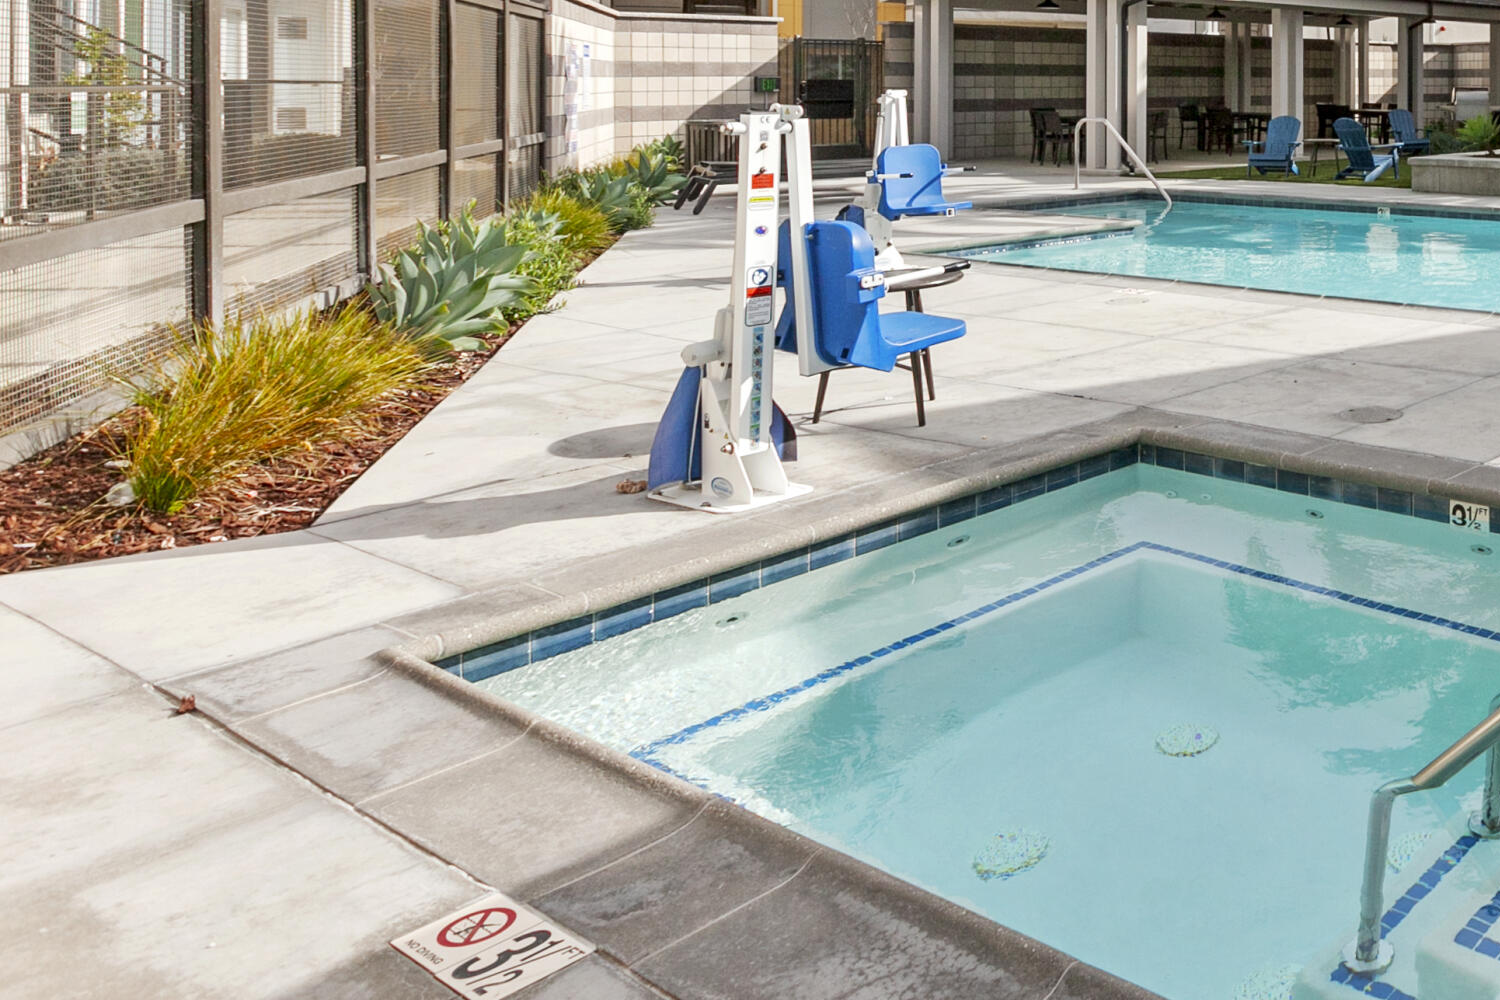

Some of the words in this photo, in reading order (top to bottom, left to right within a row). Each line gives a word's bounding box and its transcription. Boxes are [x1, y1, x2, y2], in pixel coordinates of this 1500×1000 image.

[1478, 507, 1488, 516] FT
[407, 939, 421, 949] NO
[416, 946, 444, 965] DIVING
[561, 946, 586, 960] FT
